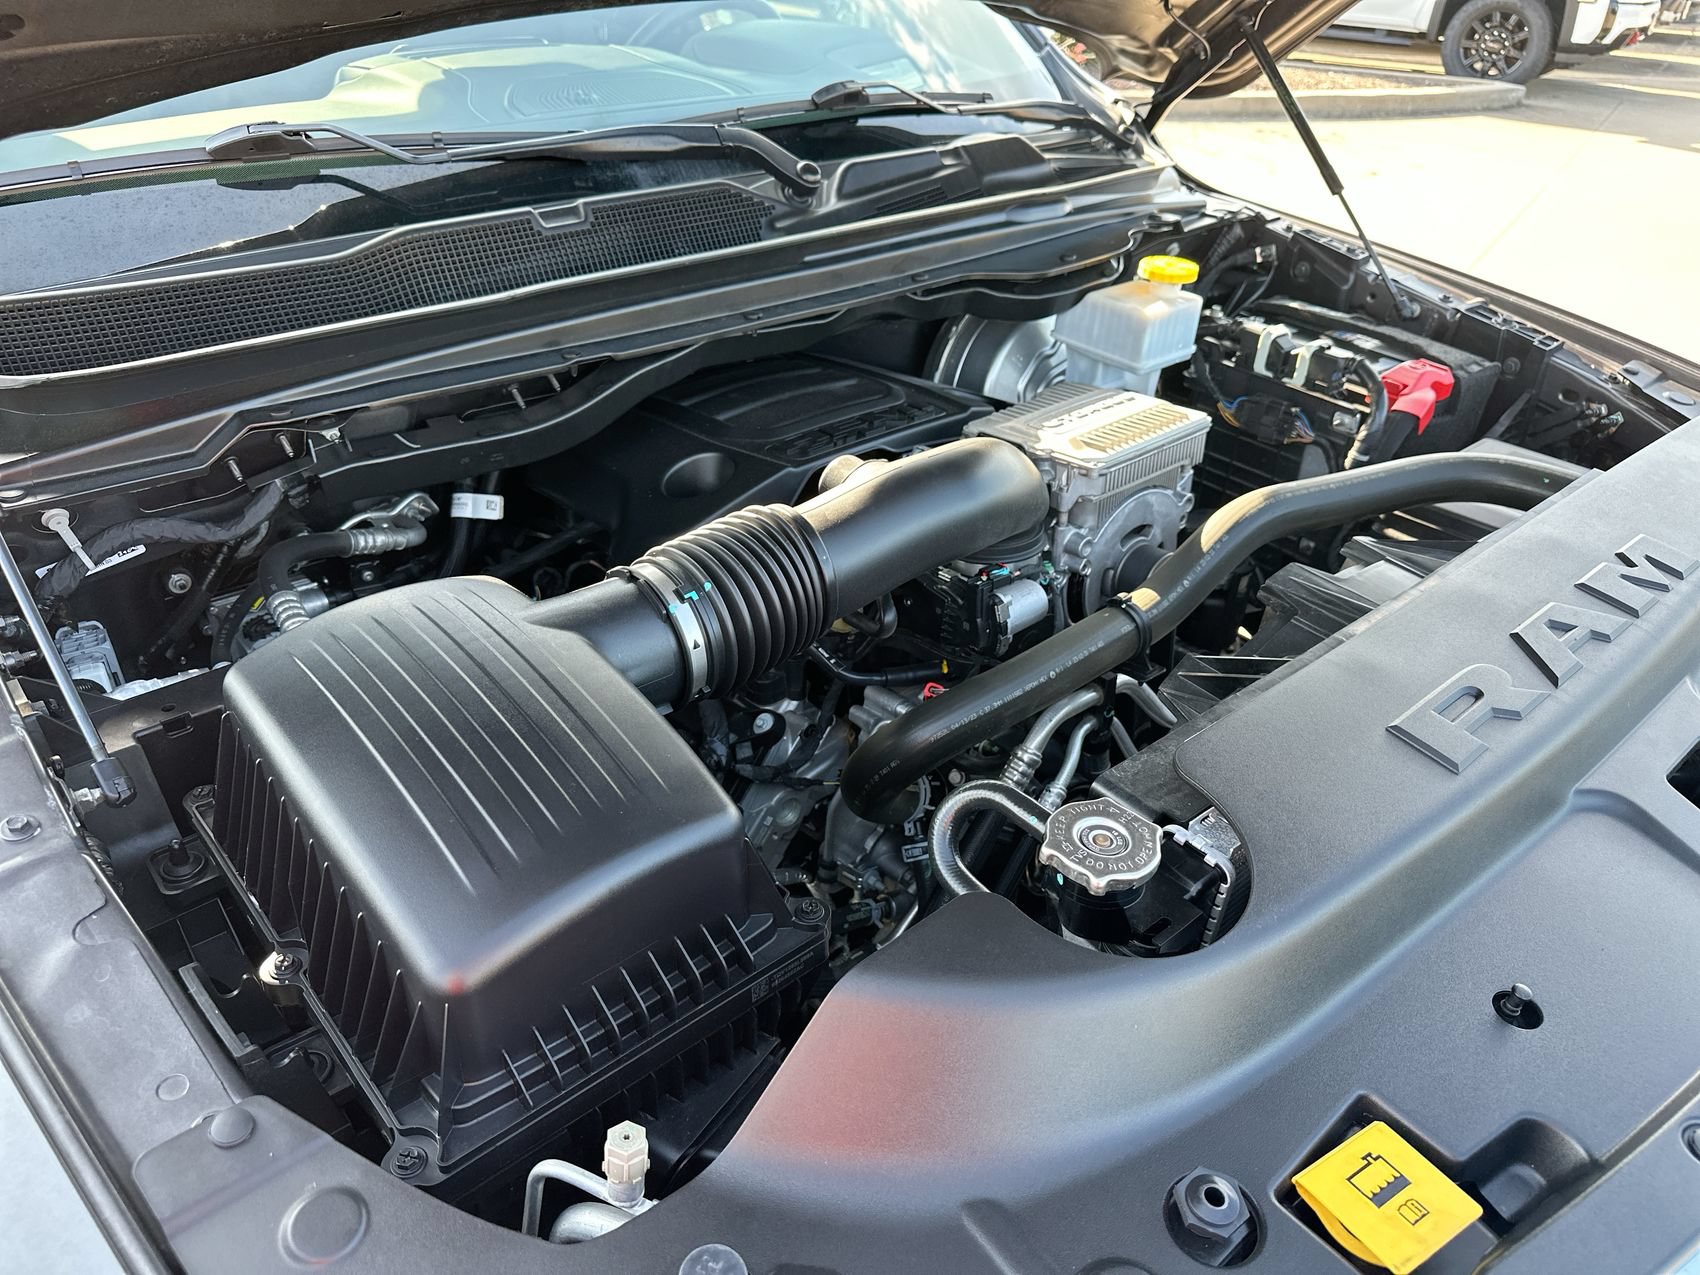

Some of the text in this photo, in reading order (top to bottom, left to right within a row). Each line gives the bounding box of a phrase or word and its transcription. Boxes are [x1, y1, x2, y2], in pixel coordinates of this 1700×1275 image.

[1385, 533, 1700, 775] RAM
[1056, 815, 1067, 840] KEEP
[1068, 803, 1104, 815] TIGHT
[1070, 849, 1088, 862] TVS
[1086, 858, 1104, 870] DO
[1108, 860, 1134, 871] NOT
[1136, 841, 1153, 865] OPEN
